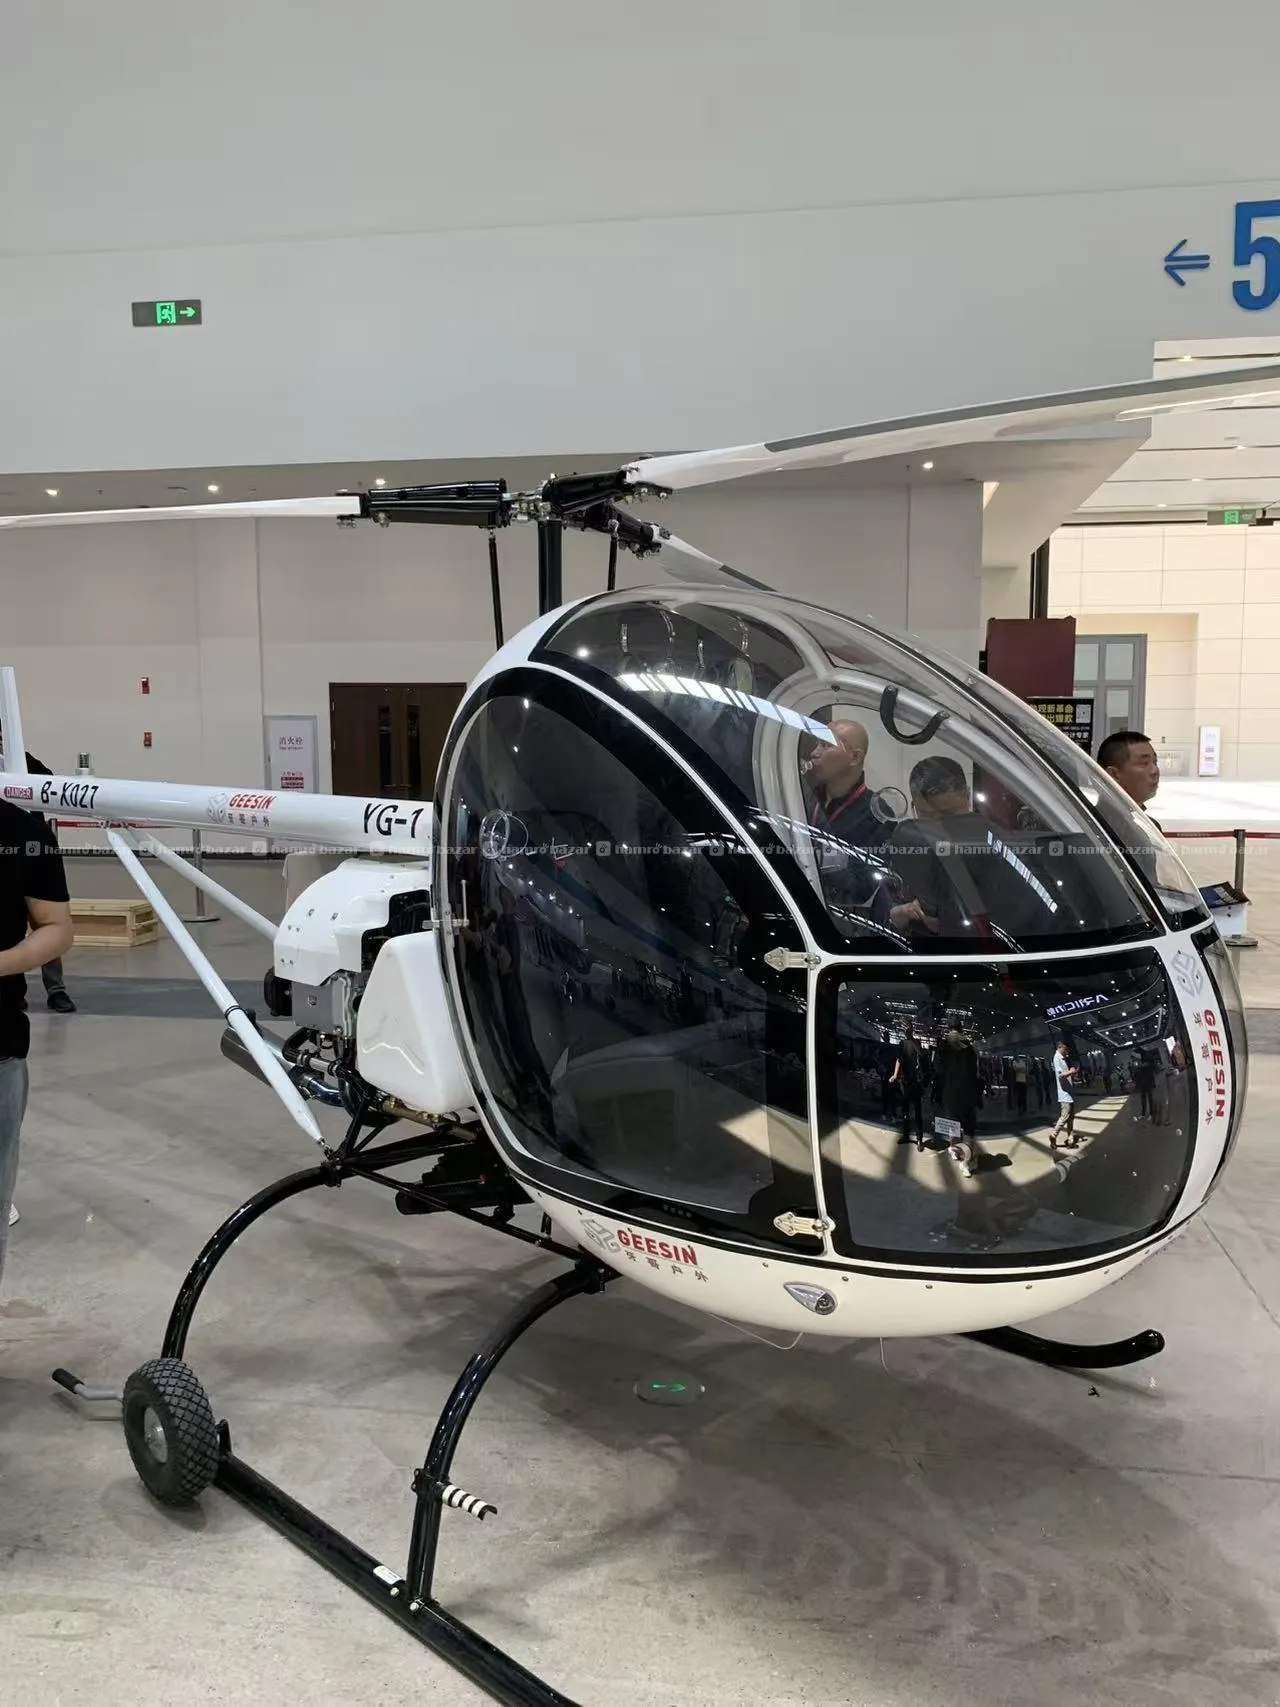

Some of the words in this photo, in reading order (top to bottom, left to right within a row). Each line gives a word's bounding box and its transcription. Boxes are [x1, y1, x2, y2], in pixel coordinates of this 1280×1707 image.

[1232, 199, 1280, 311] 5
[279, 736, 304, 745] 消火栓
[6, 787, 32, 799] DANGER
[229, 794, 276, 809] GEESIN
[364, 803, 424, 838] YG-1
[1204, 1009, 1226, 1118] GEESIN
[617, 1229, 698, 1266] GEESIN
